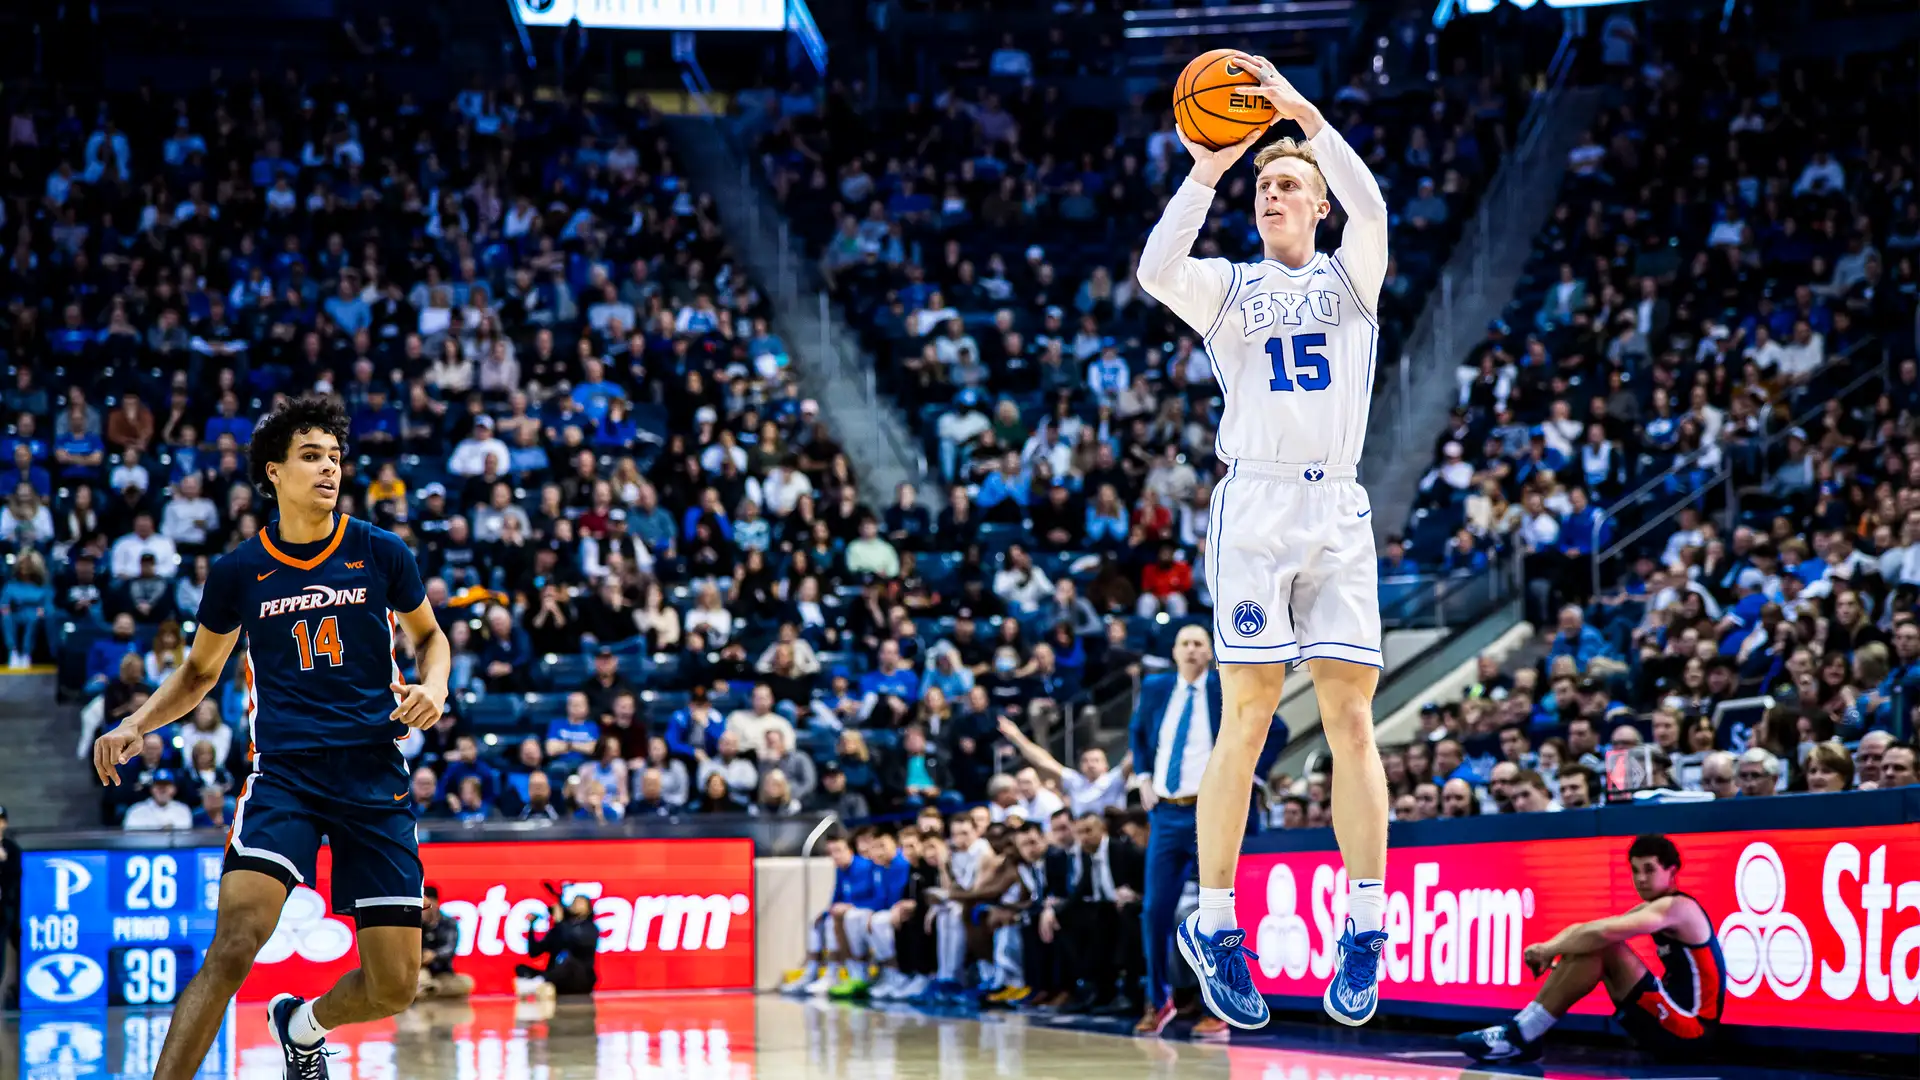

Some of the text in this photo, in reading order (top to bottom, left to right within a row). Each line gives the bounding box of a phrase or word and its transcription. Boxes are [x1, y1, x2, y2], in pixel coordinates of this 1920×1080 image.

[1240, 290, 1340, 337] BYU
[1264, 333, 1332, 391] 15
[344, 560, 365, 569] WCC
[259, 585, 367, 619] PEPPERDINE
[291, 615, 344, 671] 14
[45, 858, 92, 911] P
[126, 855, 177, 910] 26
[29, 914, 79, 951] 1:08
[124, 948, 177, 1004] 39
